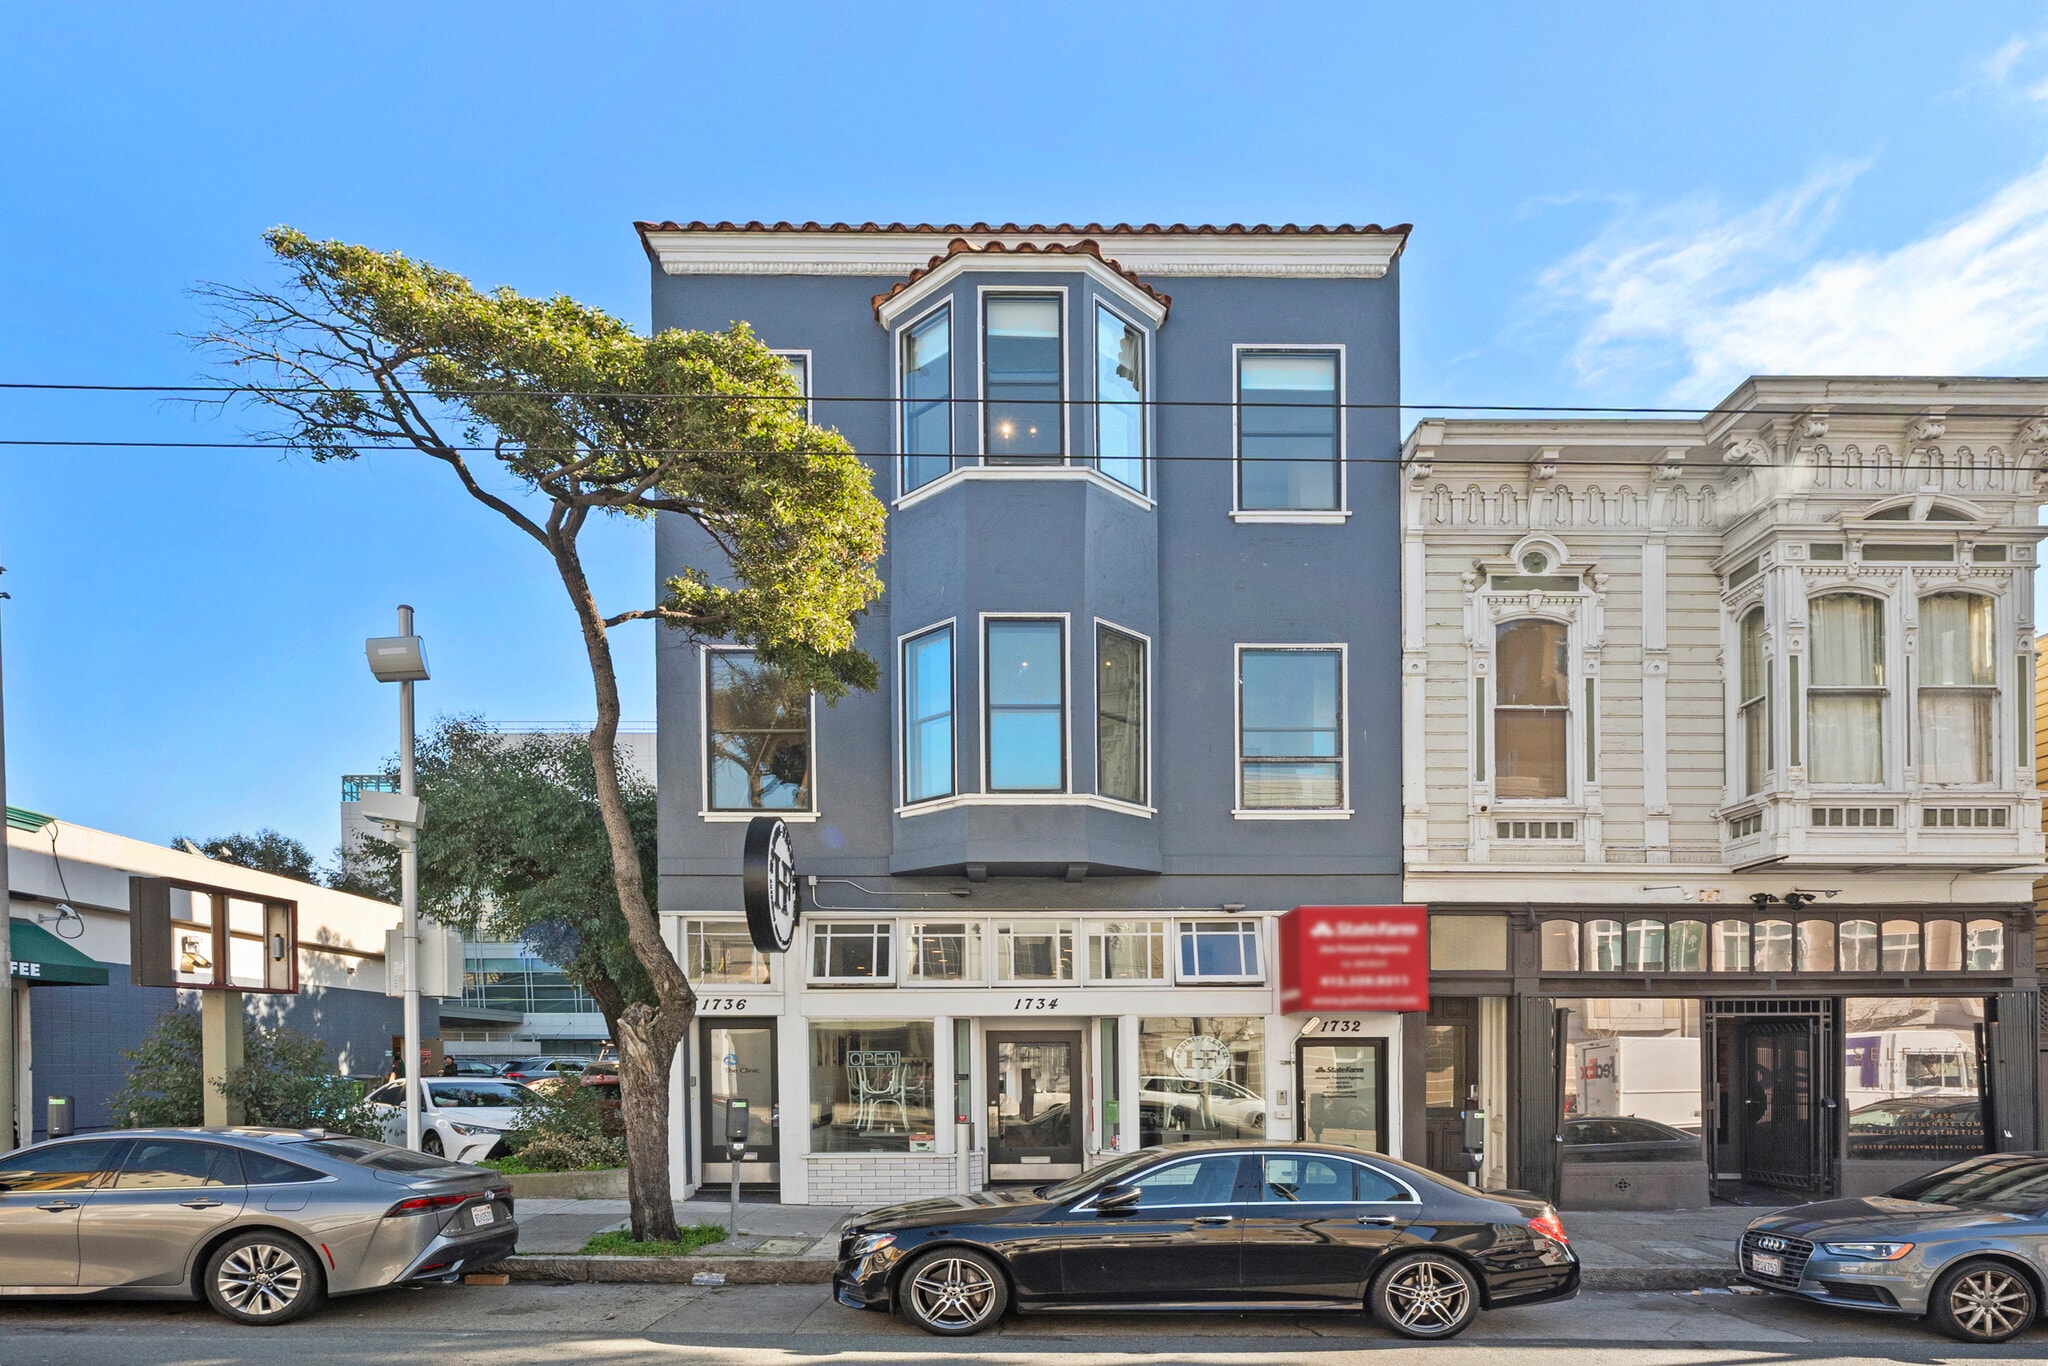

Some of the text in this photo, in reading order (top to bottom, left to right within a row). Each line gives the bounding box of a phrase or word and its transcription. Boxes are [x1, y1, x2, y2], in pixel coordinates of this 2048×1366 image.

[702, 998, 748, 1011] 1736
[1014, 998, 1059, 1010] 1734
[1320, 1020, 1361, 1033] 1732
[850, 1053, 898, 1066] OPEN
[739, 1066, 761, 1074] Clinic
